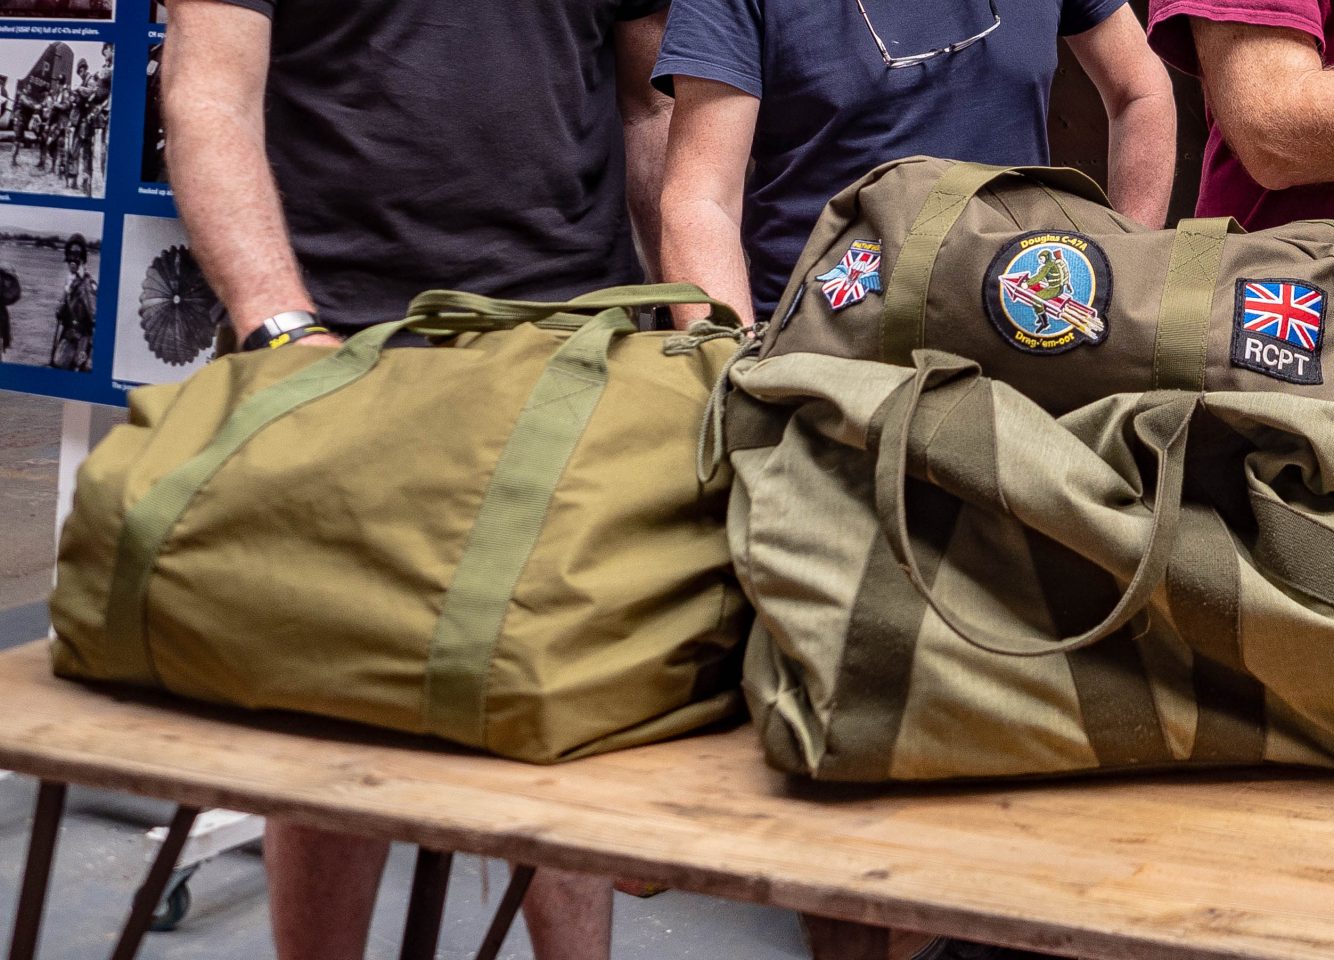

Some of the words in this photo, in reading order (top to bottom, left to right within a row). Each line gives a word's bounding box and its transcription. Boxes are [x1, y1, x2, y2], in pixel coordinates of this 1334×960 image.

[1020, 235, 1060, 249] Douglas
[1061, 235, 1088, 252] C-47A
[1244, 337, 1310, 375] RCPT
